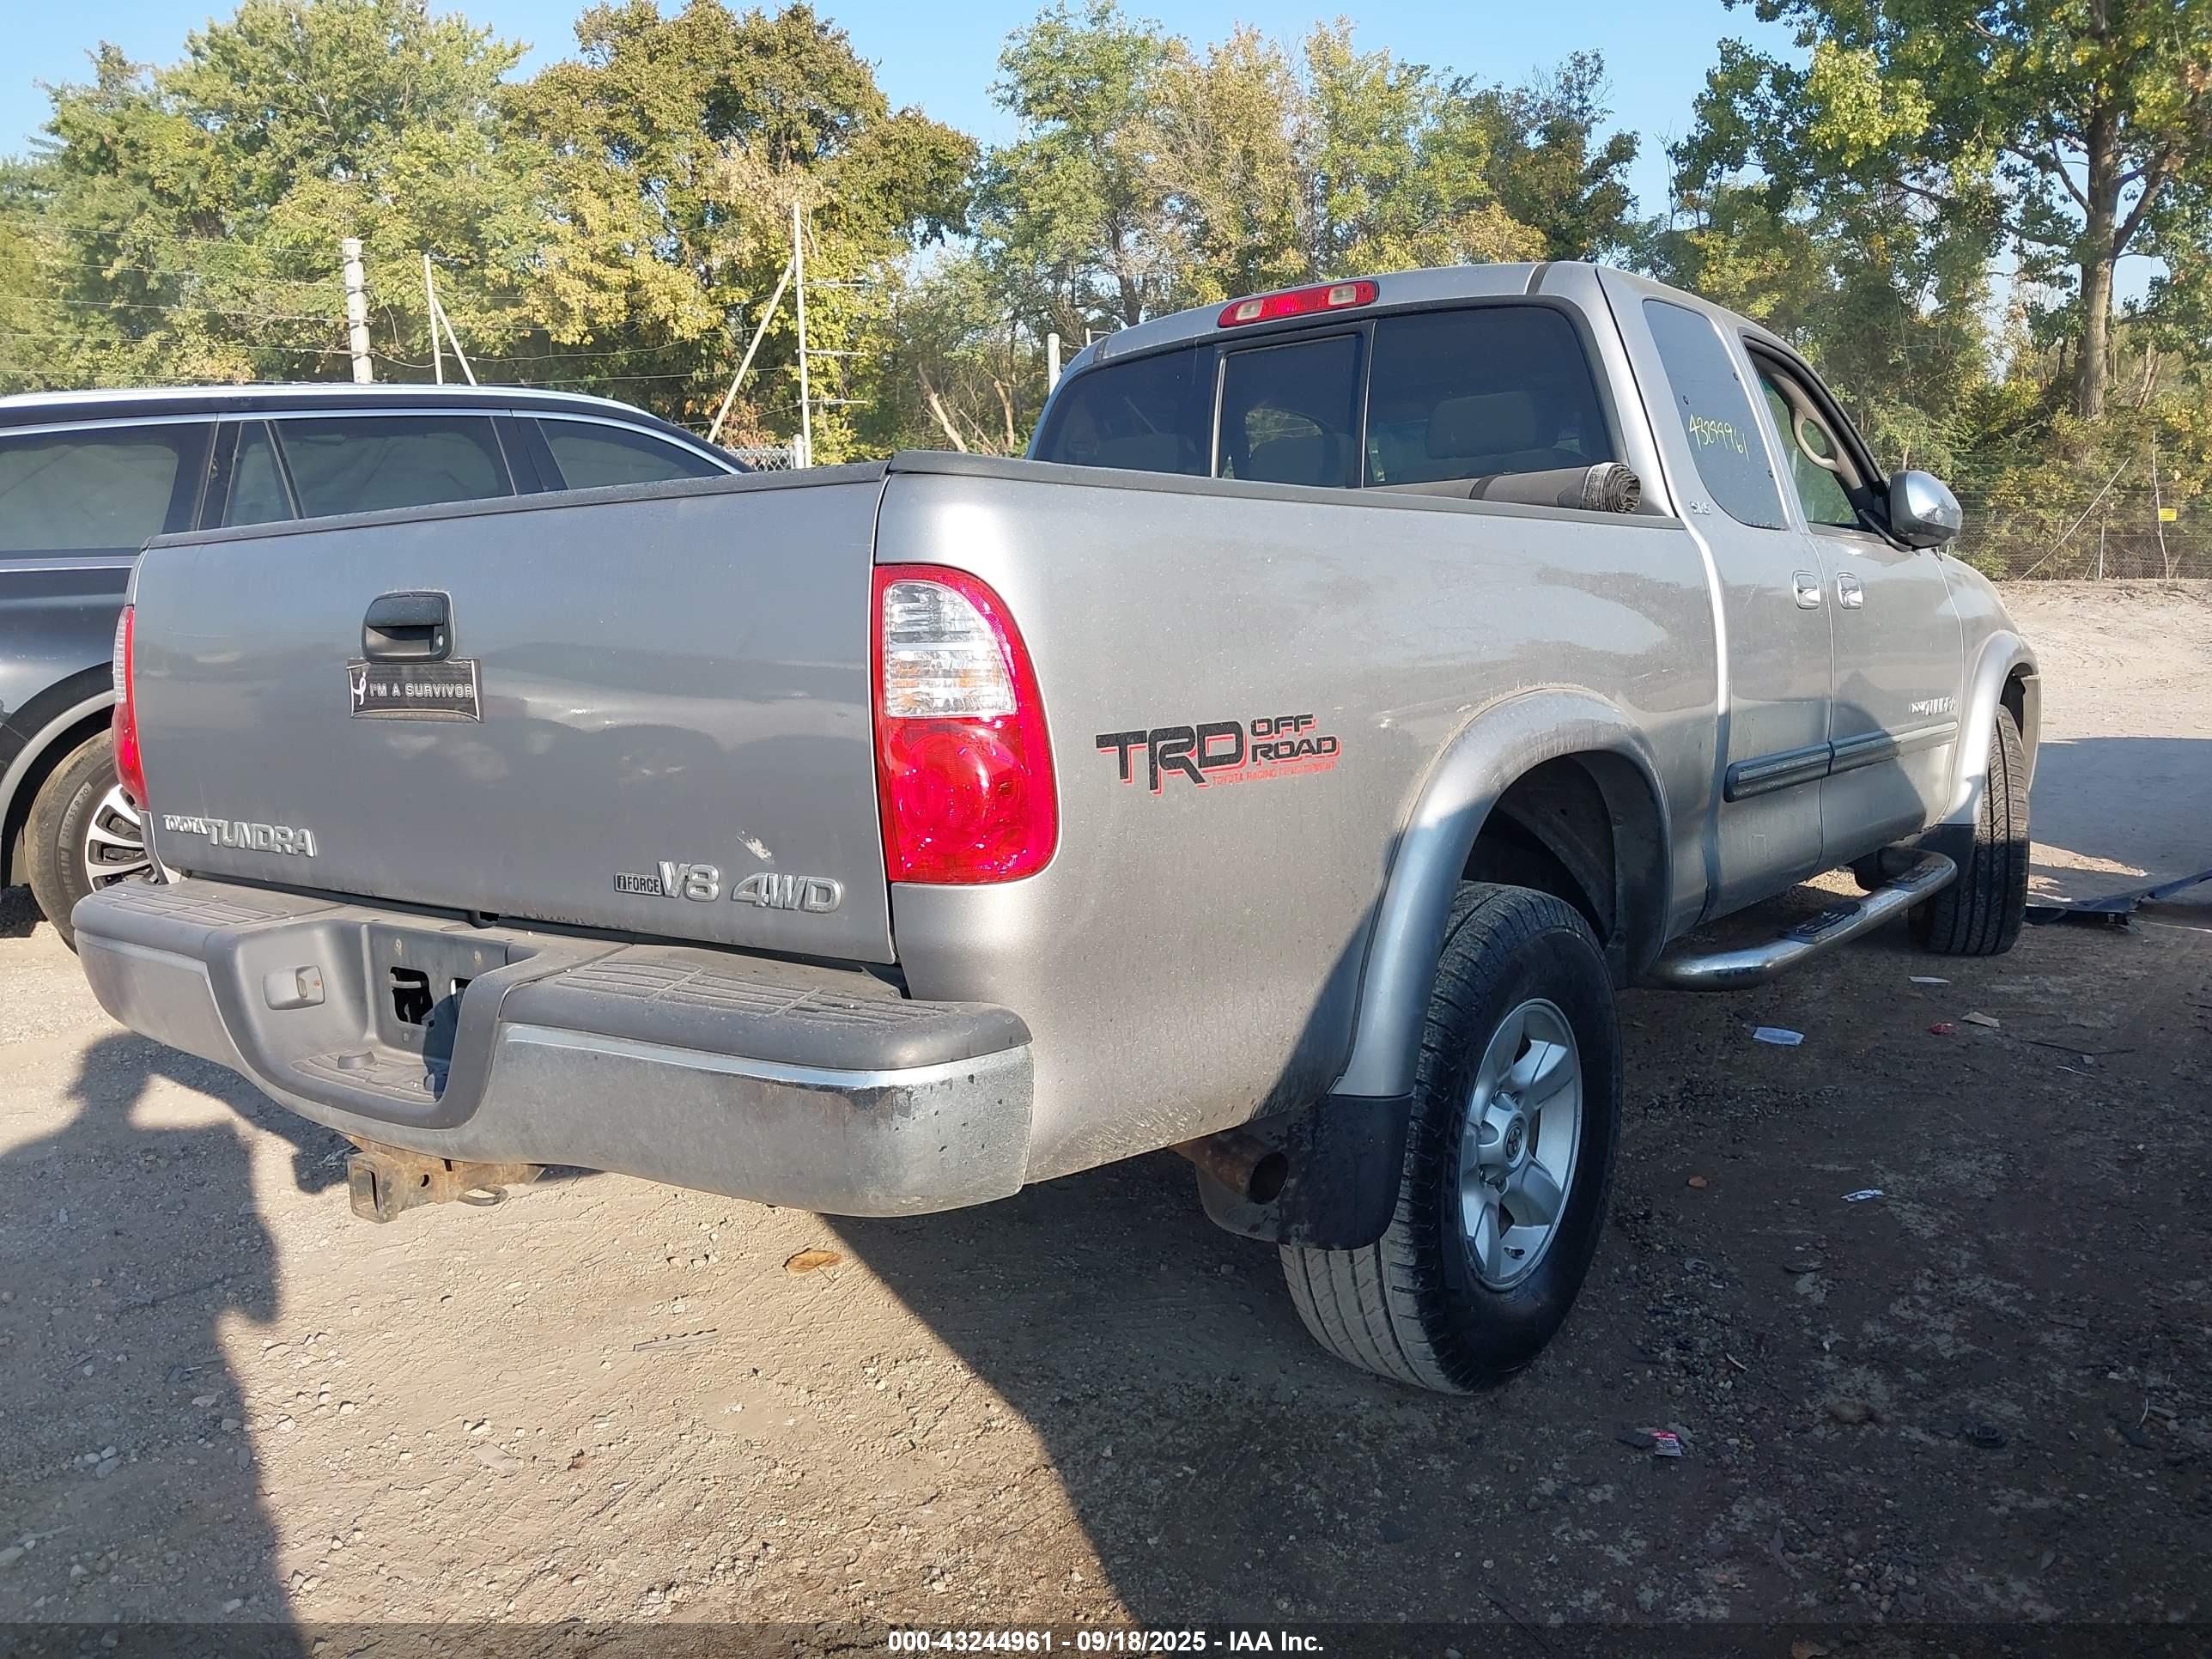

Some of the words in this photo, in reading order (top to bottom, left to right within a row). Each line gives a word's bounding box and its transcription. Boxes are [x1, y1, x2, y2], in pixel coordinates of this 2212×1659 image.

[369, 683, 387, 697] I'M
[392, 683, 401, 697] A
[404, 684, 474, 698] SURVIVOR
[1250, 714, 1316, 739] OFF
[1096, 720, 1247, 795] TRD
[1251, 736, 1340, 765] ROAD
[162, 814, 209, 835] TOYOTA
[204, 818, 317, 857] TUNDRA
[658, 860, 720, 902] V8
[731, 872, 843, 914] 4WD
